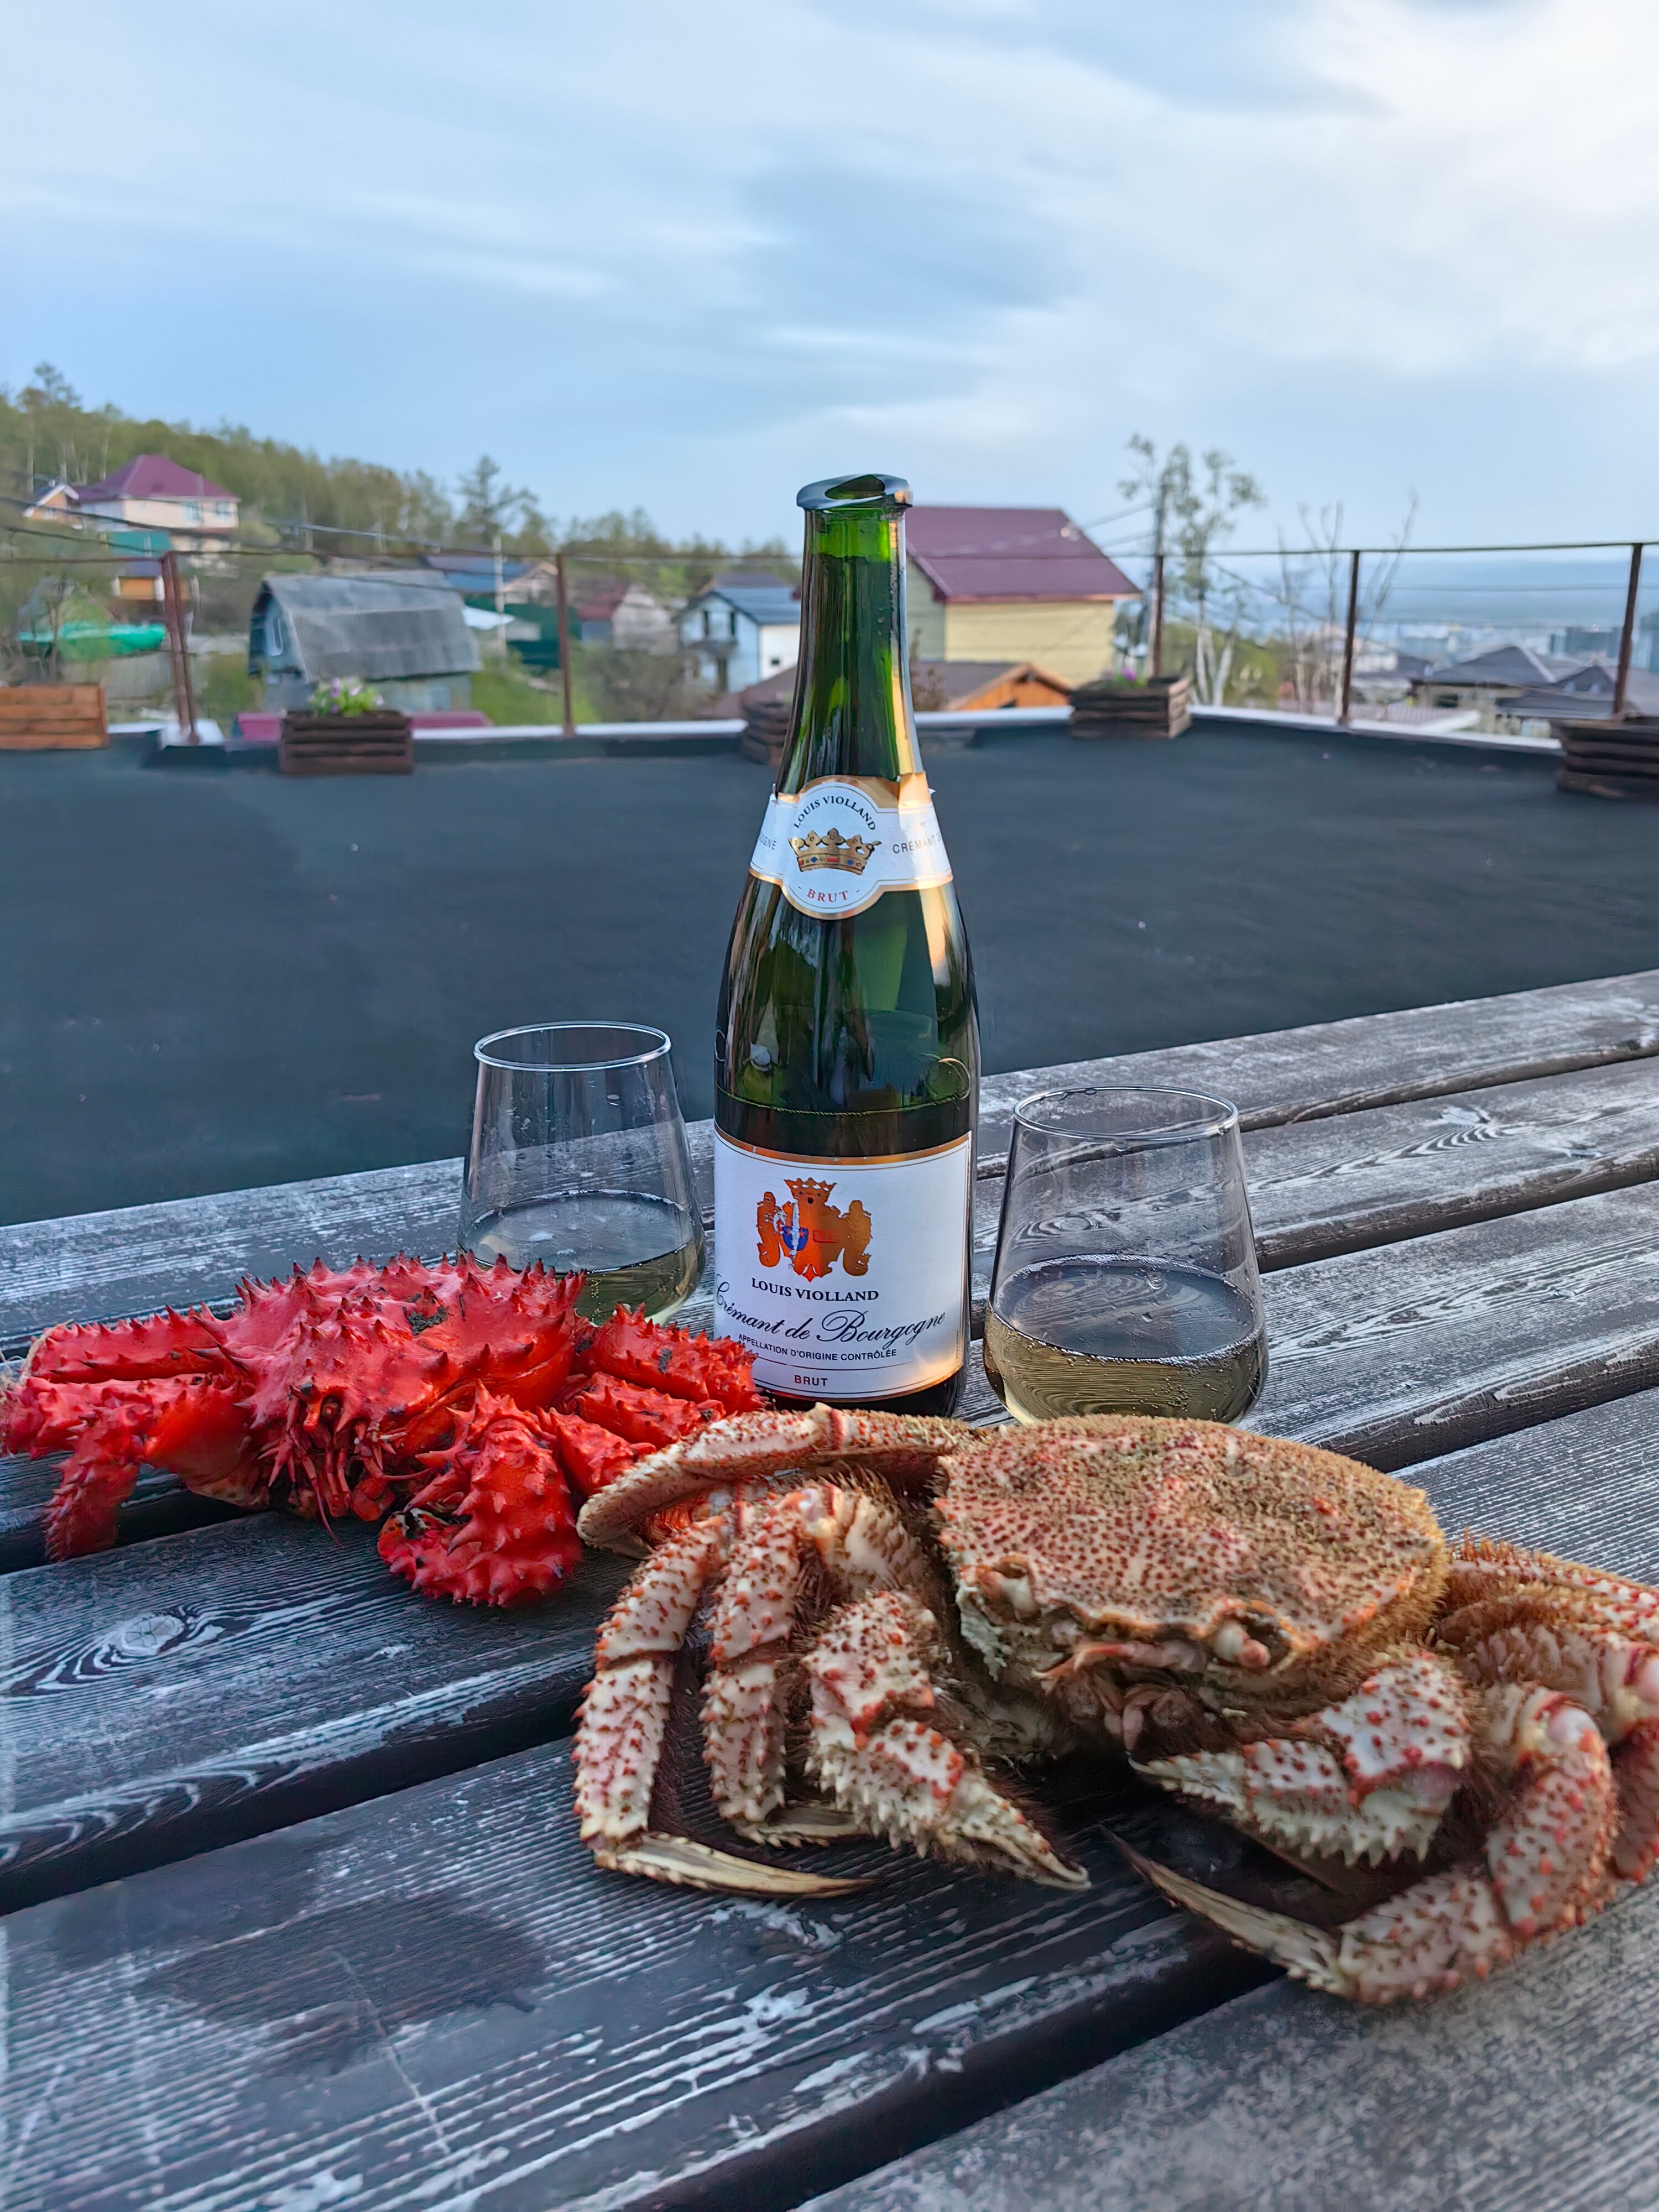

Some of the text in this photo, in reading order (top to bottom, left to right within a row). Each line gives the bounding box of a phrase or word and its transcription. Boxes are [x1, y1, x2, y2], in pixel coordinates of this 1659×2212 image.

[794, 796, 876, 831] LOUIS VIOLLAND
[807, 888, 848, 902] BRUT
[752, 1277, 879, 1301] LOUIS VIOLLAND
[716, 1274, 785, 1334] Crémant
[785, 1318, 813, 1339] de
[816, 1310, 946, 1350] Bourgogne
[738, 1333, 898, 1361] APPELLATION D'ORIGINE CONTRÔLÉE
[794, 1375, 828, 1387] BRUT
